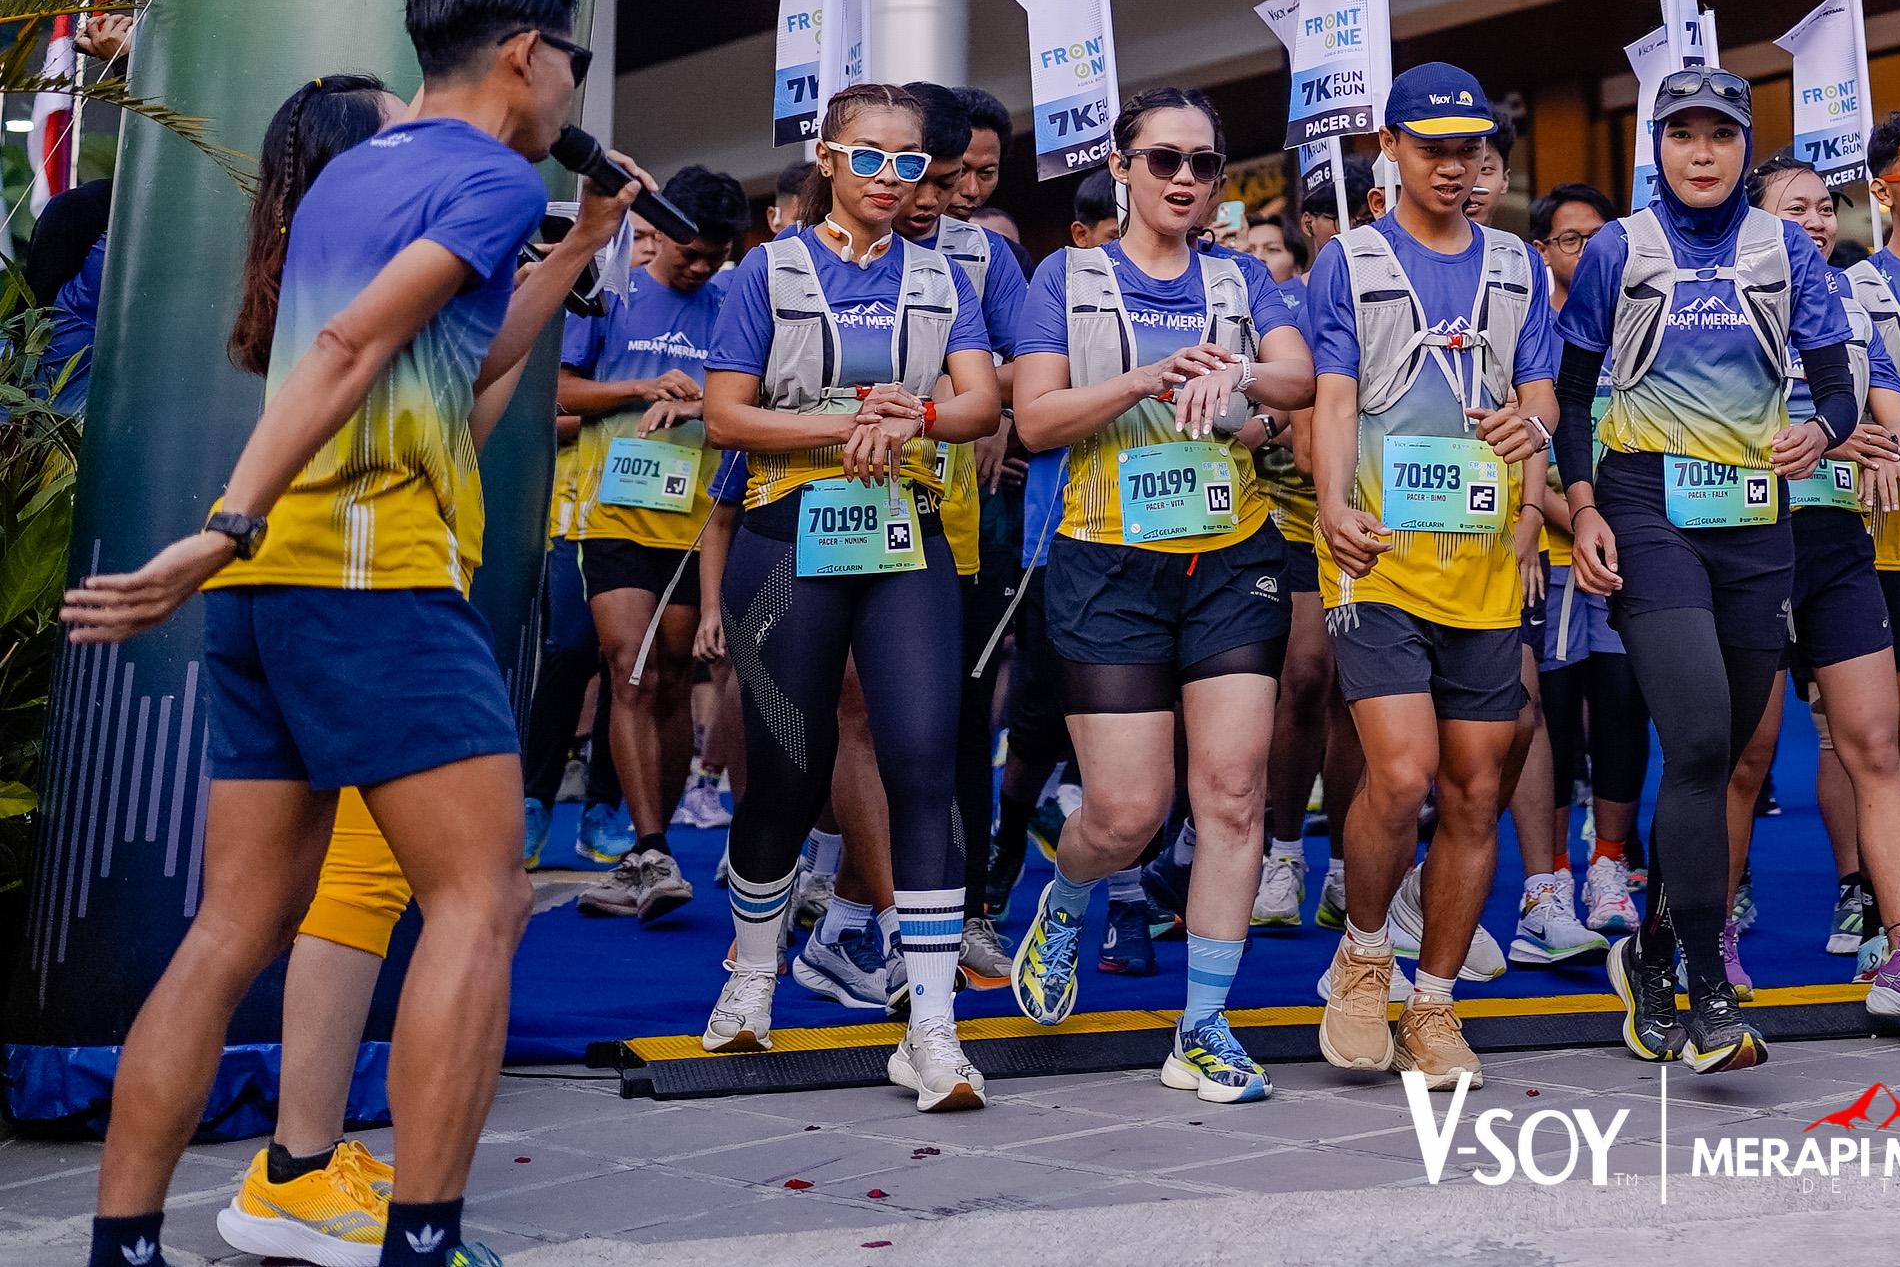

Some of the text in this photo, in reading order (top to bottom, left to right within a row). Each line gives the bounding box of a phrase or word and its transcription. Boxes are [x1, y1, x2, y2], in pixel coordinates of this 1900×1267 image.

[786, 9, 823, 33] FRO
[1305, 8, 1362, 36] FRONT
[1325, 28, 1362, 50] ONE
[1074, 55, 1106, 79] ON
[1333, 70, 1363, 85] FUN
[1301, 75, 1333, 107] 7K
[1333, 83, 1365, 98] RUN
[1802, 80, 1857, 105] FRONT
[1095, 96, 1108, 113] FU
[1827, 96, 1858, 116] ONE
[1048, 103, 1098, 137] 7K
[1305, 112, 1368, 138] PACER 6
[1841, 131, 1861, 146] FUN
[1804, 136, 1842, 167] 7K
[1842, 142, 1863, 156] RUN
[1306, 169, 1324, 190] PACER
[1824, 165, 1865, 188] ACER 7
[831, 312, 864, 325] RAPI
[1128, 312, 1206, 328] RAPI MERB
[1667, 313, 1750, 326] RAPI MERBA
[628, 340, 668, 352] MERAPI
[667, 343, 709, 359] MERBAB
[611, 456, 661, 478] 70071
[1393, 462, 1461, 490] 70193
[1673, 459, 1739, 487] 70194
[1127, 467, 1197, 500] 70199
[1145, 502, 1165, 511] PACER
[1170, 499, 1185, 508] VITA
[1406, 493, 1425, 501] PACER
[808, 505, 878, 533] 70198
[1416, 520, 1445, 528] GELARIN
[818, 537, 839, 546] PACER
[1159, 526, 1188, 537] GELARIN
[833, 564, 863, 572] GELARIN
